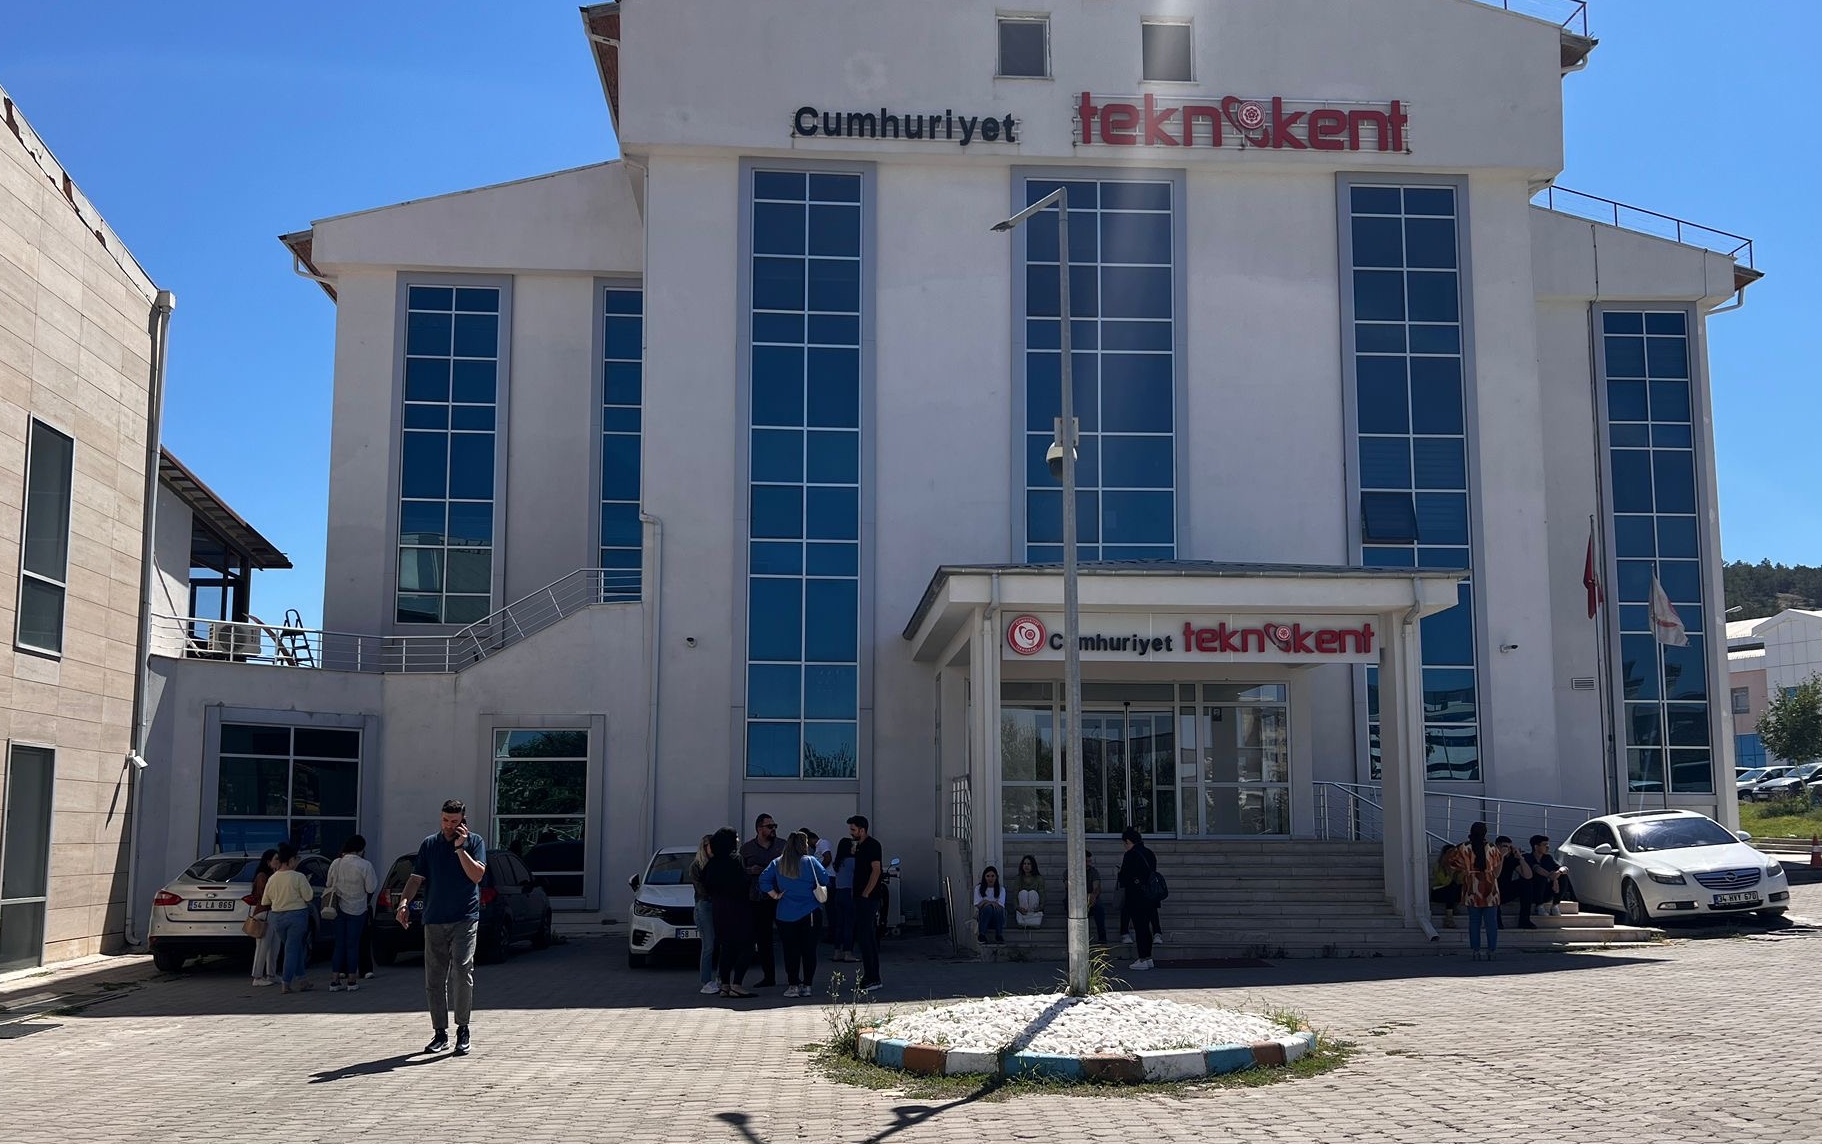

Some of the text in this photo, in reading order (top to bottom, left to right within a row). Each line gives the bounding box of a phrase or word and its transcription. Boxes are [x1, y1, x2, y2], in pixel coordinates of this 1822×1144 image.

[794, 106, 1016, 146] Cumhuriyet
[1049, 633, 1173, 656] Cmhuriyet
[1744, 892, 1757, 900] 670
[681, 930, 689, 938] 58
